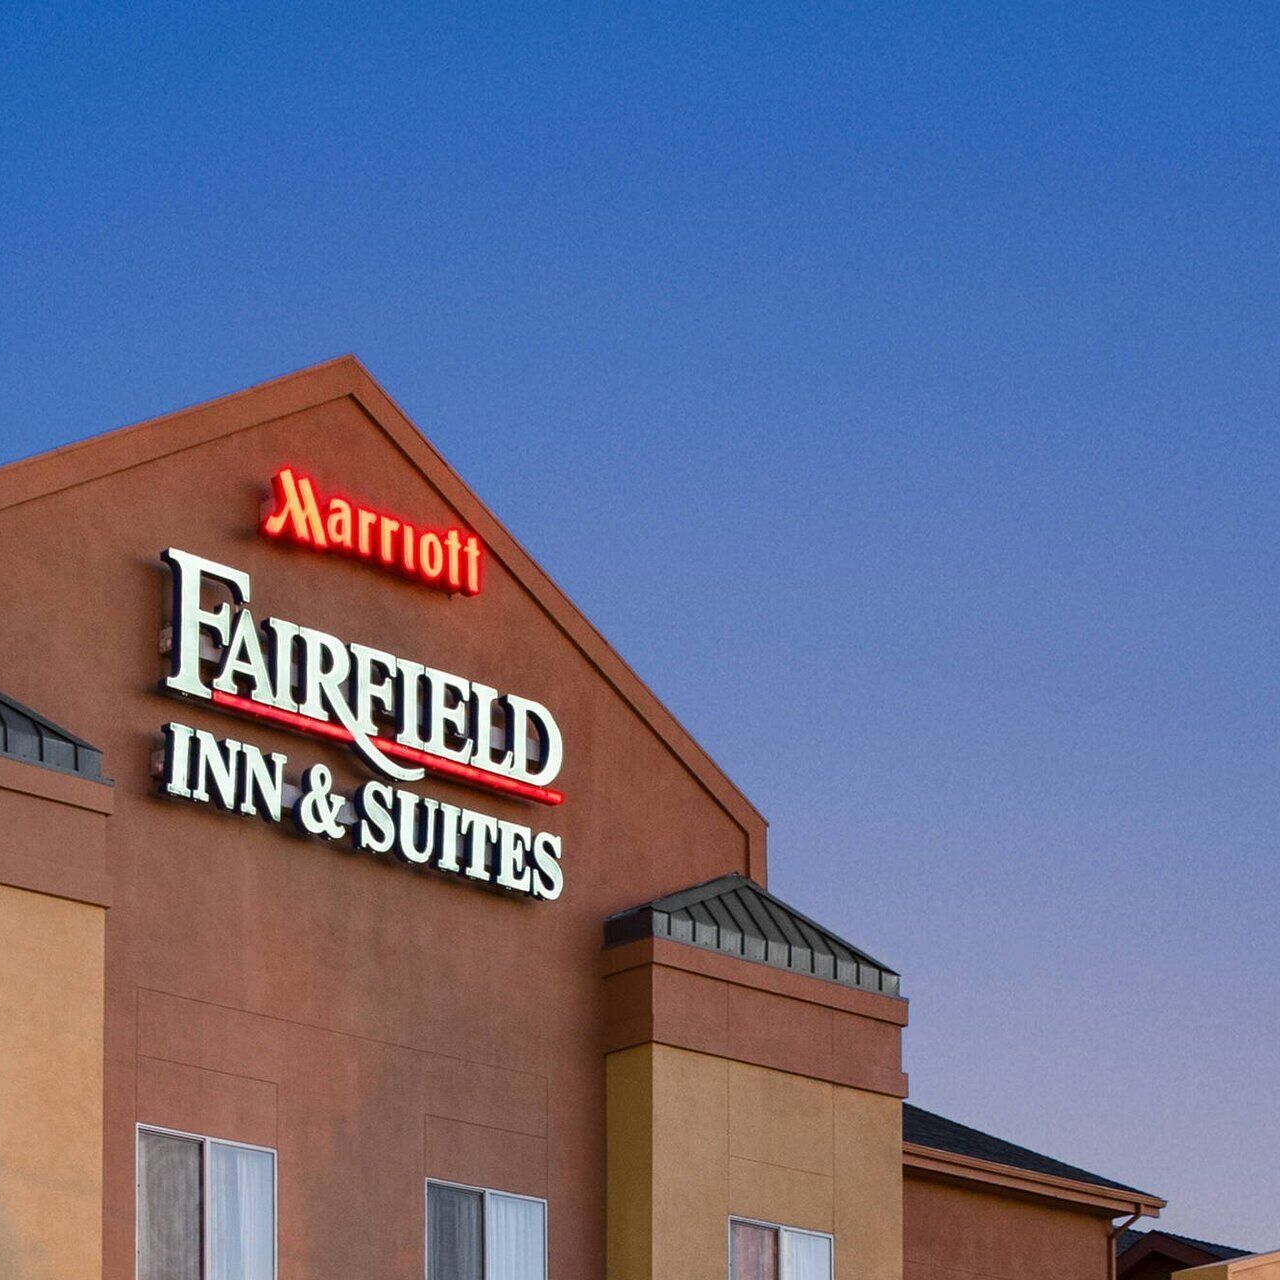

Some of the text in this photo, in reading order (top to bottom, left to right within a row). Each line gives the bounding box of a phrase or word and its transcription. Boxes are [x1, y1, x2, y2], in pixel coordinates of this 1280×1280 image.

[263, 466, 483, 594] Marriott
[163, 547, 564, 788] FAIRFIELD
[165, 722, 565, 901] INN & SUITES
